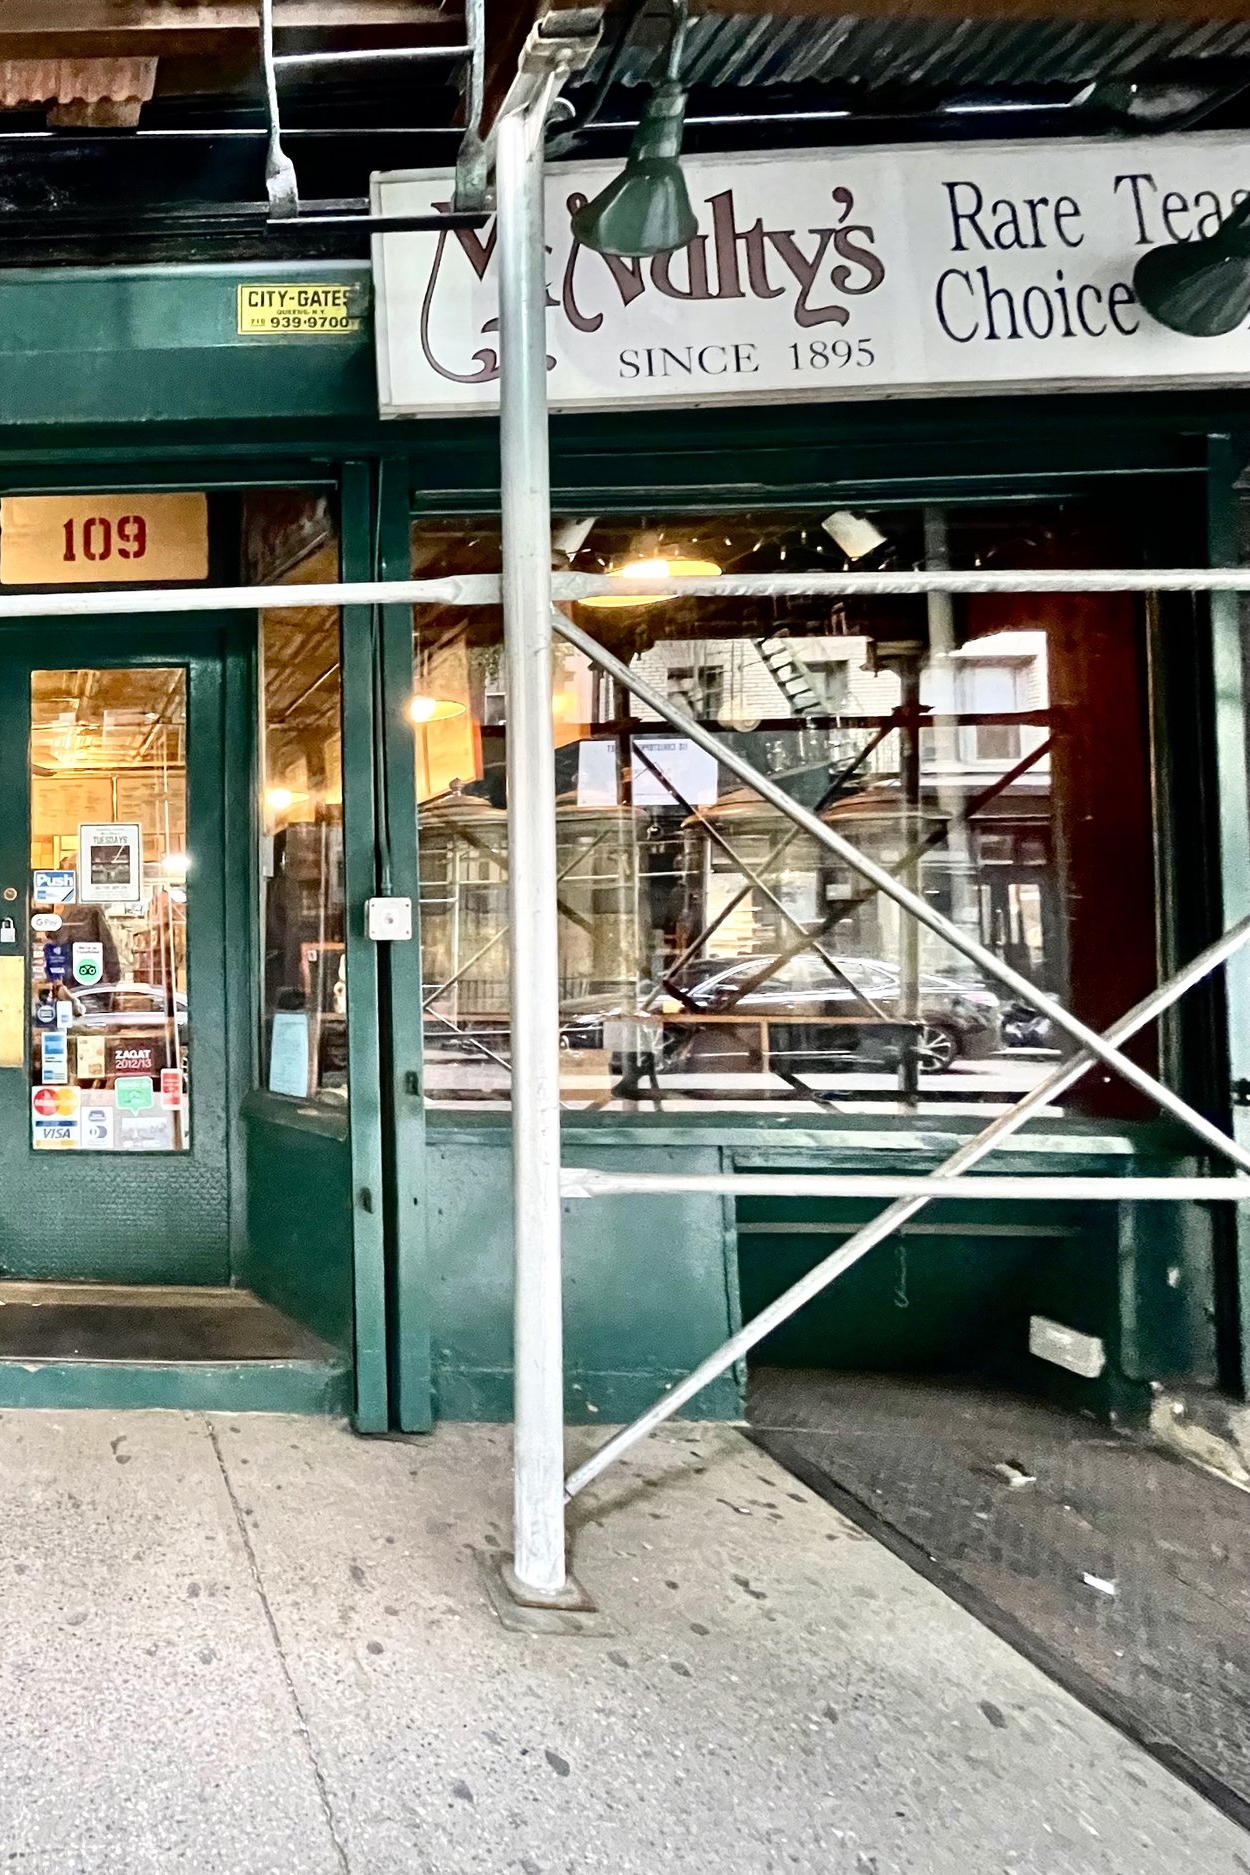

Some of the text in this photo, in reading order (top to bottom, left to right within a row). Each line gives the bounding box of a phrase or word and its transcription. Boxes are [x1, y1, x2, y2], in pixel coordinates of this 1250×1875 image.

[941, 181, 1085, 251] Rare
[935, 265, 1140, 343] Choice
[618, 338, 876, 379] SINCE 1895
[63, 515, 147, 561] 109
[92, 836, 129, 845] TUESDAYS
[36, 873, 74, 888] Push
[115, 1050, 151, 1059] ZAGAT
[115, 1058, 152, 1069] 2012/13
[43, 1128, 71, 1139] VISA
